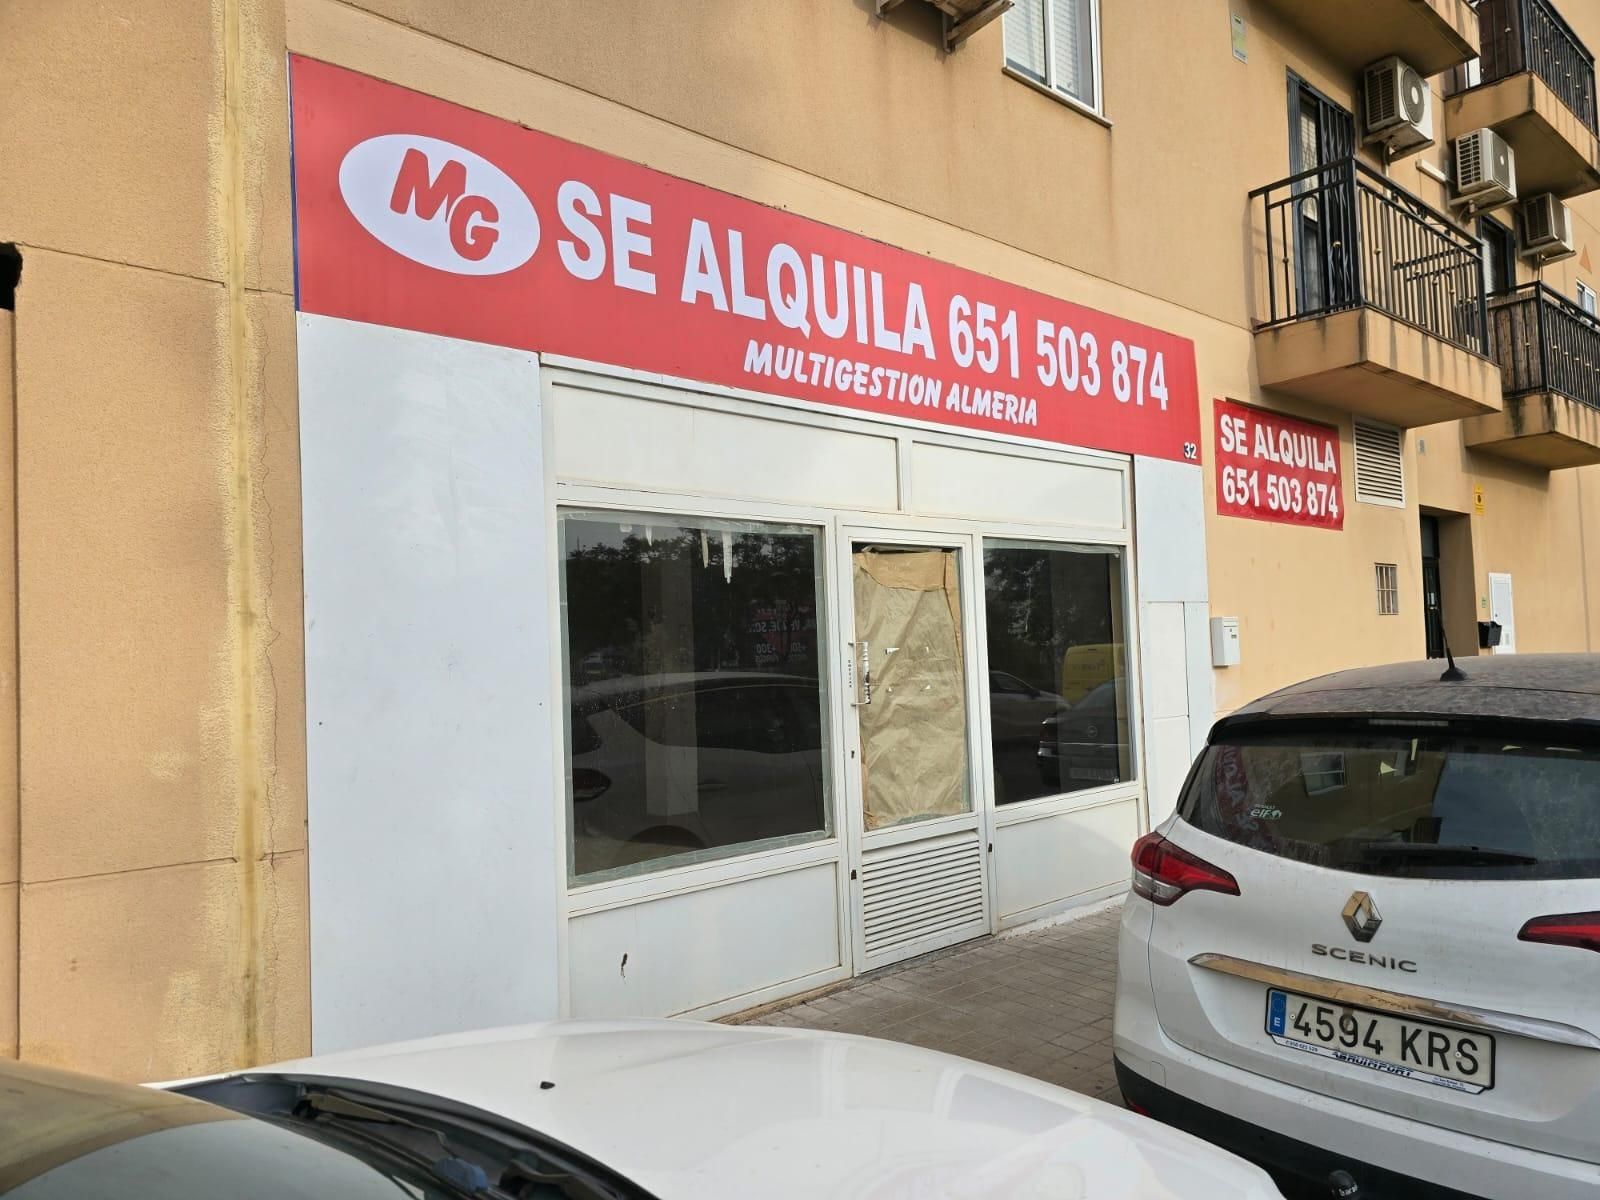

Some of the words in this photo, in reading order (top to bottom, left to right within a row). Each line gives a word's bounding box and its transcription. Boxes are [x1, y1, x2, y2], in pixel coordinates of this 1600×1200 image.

[390, 148, 499, 261] MG
[557, 180, 657, 294] SE
[680, 218, 937, 360] ALQUILA
[948, 294, 1020, 379] 651
[1036, 319, 1101, 397] 503
[1111, 340, 1169, 411] 874
[743, 339, 942, 409] MULTIGESTION
[945, 382, 1037, 426] ALMERIA
[1184, 442, 1197, 459] 32
[1220, 414, 1248, 456] SE
[1254, 423, 1337, 474] ALQUILA
[1222, 465, 1260, 507] 651
[1266, 474, 1302, 514] 503
[1306, 481, 1338, 519] 874
[1311, 943, 1417, 973] SCENIC
[1293, 1002, 1384, 1056] 4594
[1401, 1025, 1479, 1076] KRS
